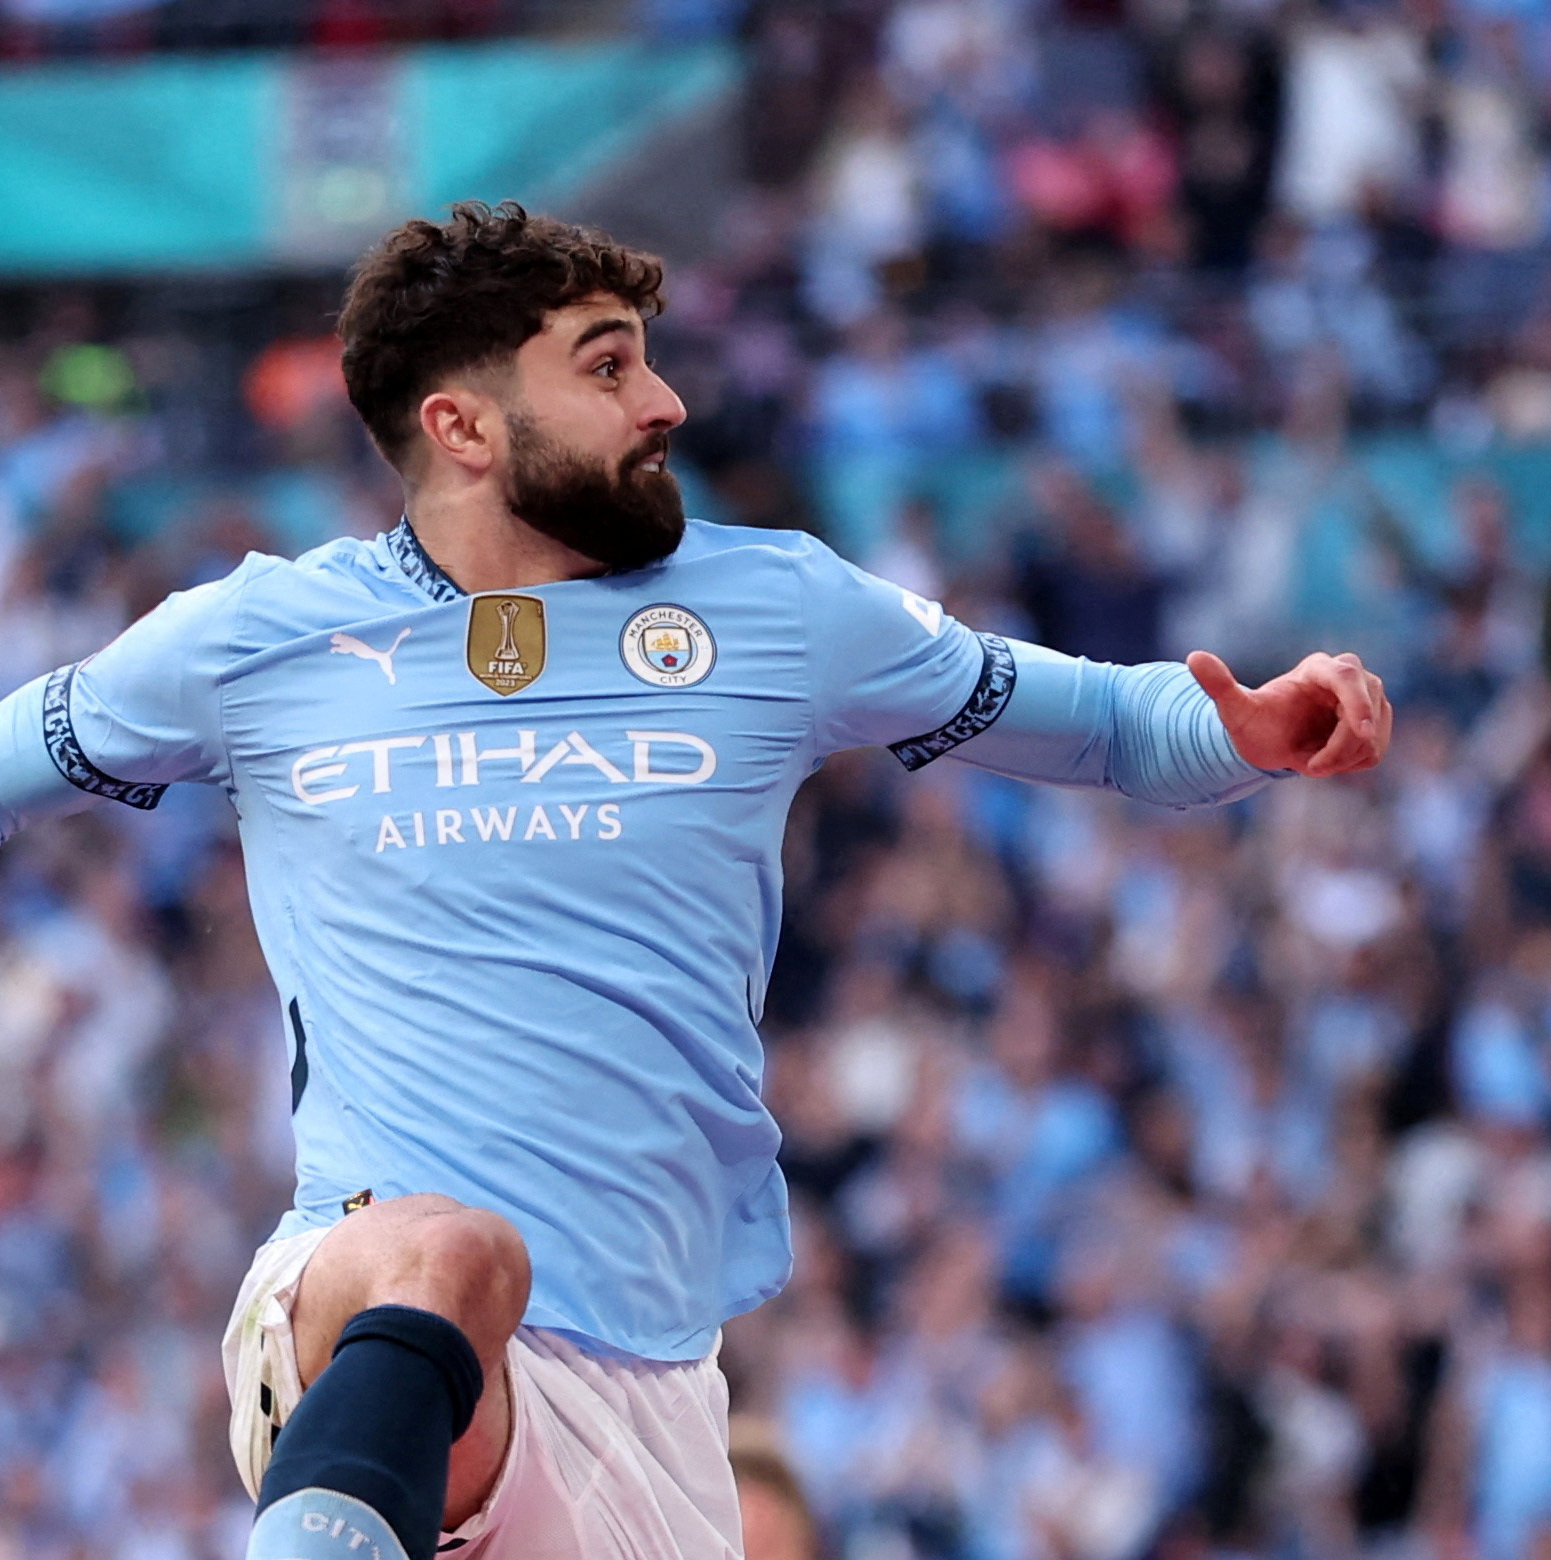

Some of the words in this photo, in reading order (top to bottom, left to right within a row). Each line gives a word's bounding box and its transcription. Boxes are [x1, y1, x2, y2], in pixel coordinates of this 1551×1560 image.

[629, 611, 703, 638] MANCHESTER
[488, 661, 524, 674] FIFA
[660, 676, 687, 684] CITY
[291, 730, 717, 805] ETIHAD
[375, 803, 623, 853] AIRWAYS
